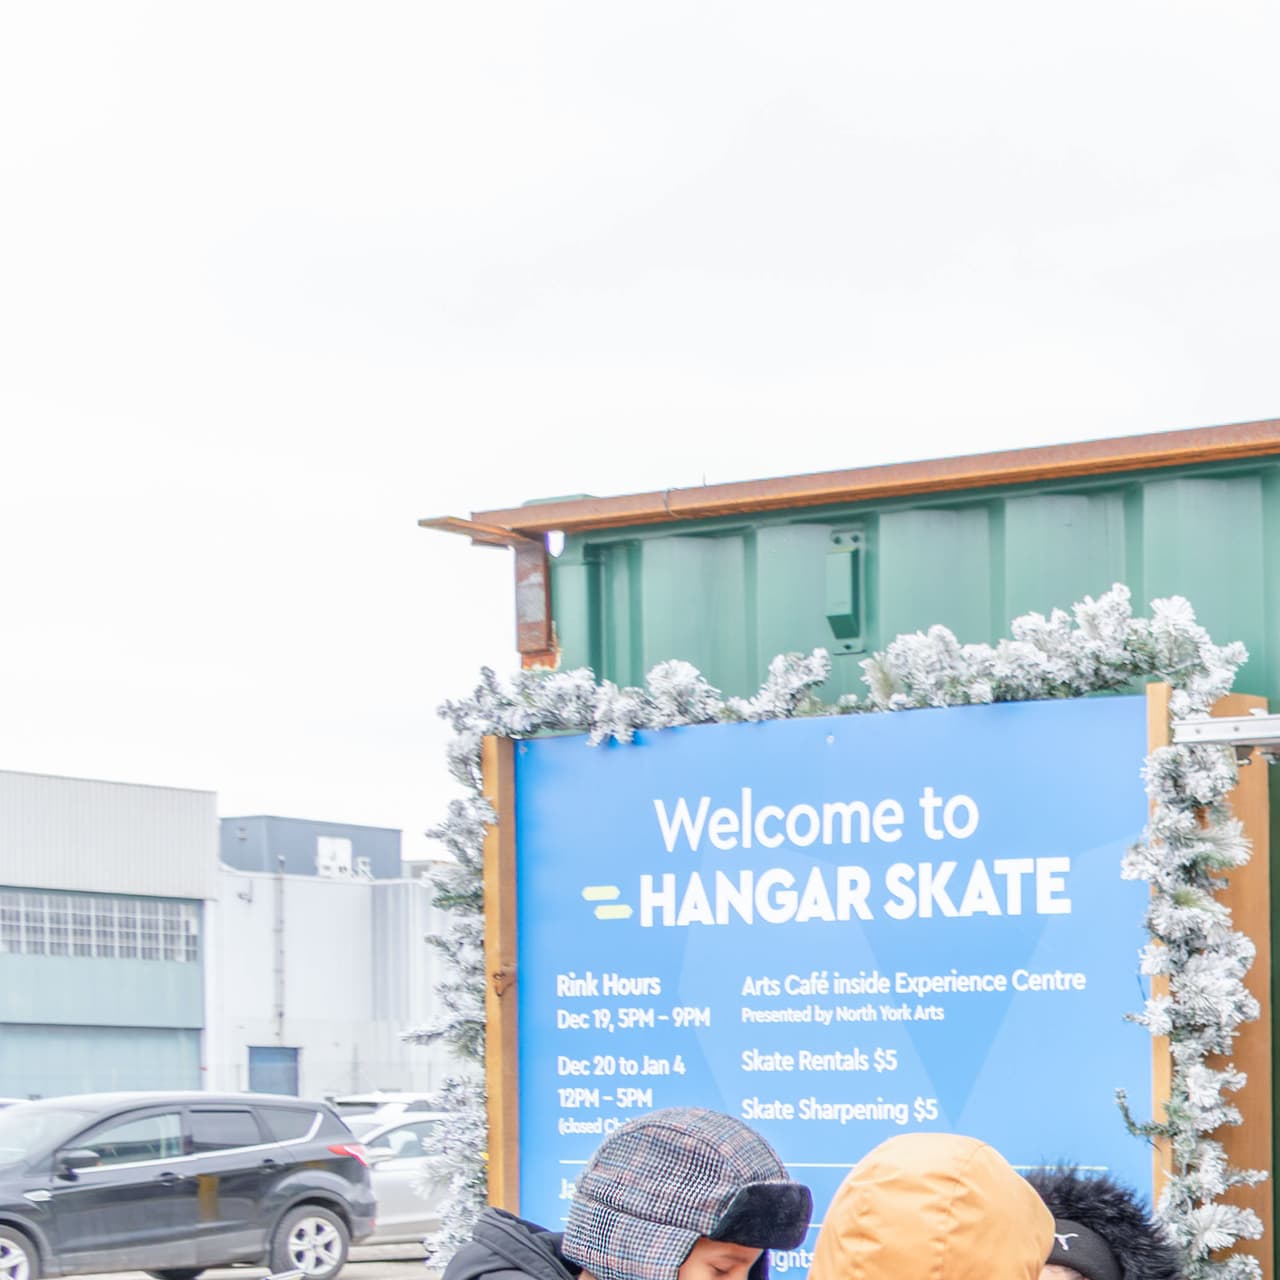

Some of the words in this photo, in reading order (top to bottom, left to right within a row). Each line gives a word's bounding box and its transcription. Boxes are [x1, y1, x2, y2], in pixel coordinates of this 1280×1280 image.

[653, 787, 902, 852] Welcome
[919, 787, 980, 840] to
[639, 865, 873, 928] HANGAR
[883, 857, 1072, 918] SKATE
[557, 972, 599, 997] Rink
[602, 973, 661, 996] Hours
[742, 976, 780, 995] Arts
[784, 971, 829, 995] Café
[834, 970, 890, 993] inside
[895, 969, 1007, 997] Experience
[1012, 970, 1086, 991] Centre
[557, 1009, 589, 1029] Dec
[592, 1009, 615, 1032] 19,
[617, 1008, 655, 1028] 5PM
[672, 1007, 711, 1027] 9PM
[742, 1005, 812, 1023] Presented
[814, 1005, 833, 1025] by
[836, 1004, 877, 1021] North
[880, 1004, 912, 1021] York
[914, 1005, 944, 1020] Arts
[557, 1056, 590, 1076] Dec
[593, 1056, 615, 1075] 20
[618, 1057, 638, 1075] to
[640, 1056, 670, 1075] Jan
[672, 1055, 686, 1075] 4
[742, 1049, 794, 1071] Skate
[799, 1048, 869, 1071] Rentals
[874, 1048, 897, 1073] $5
[558, 1088, 600, 1108] 12PM
[616, 1088, 653, 1108] 5PM
[741, 1098, 794, 1120] Skate
[799, 1097, 908, 1125] Sharpening
[914, 1096, 938, 1122] $5
